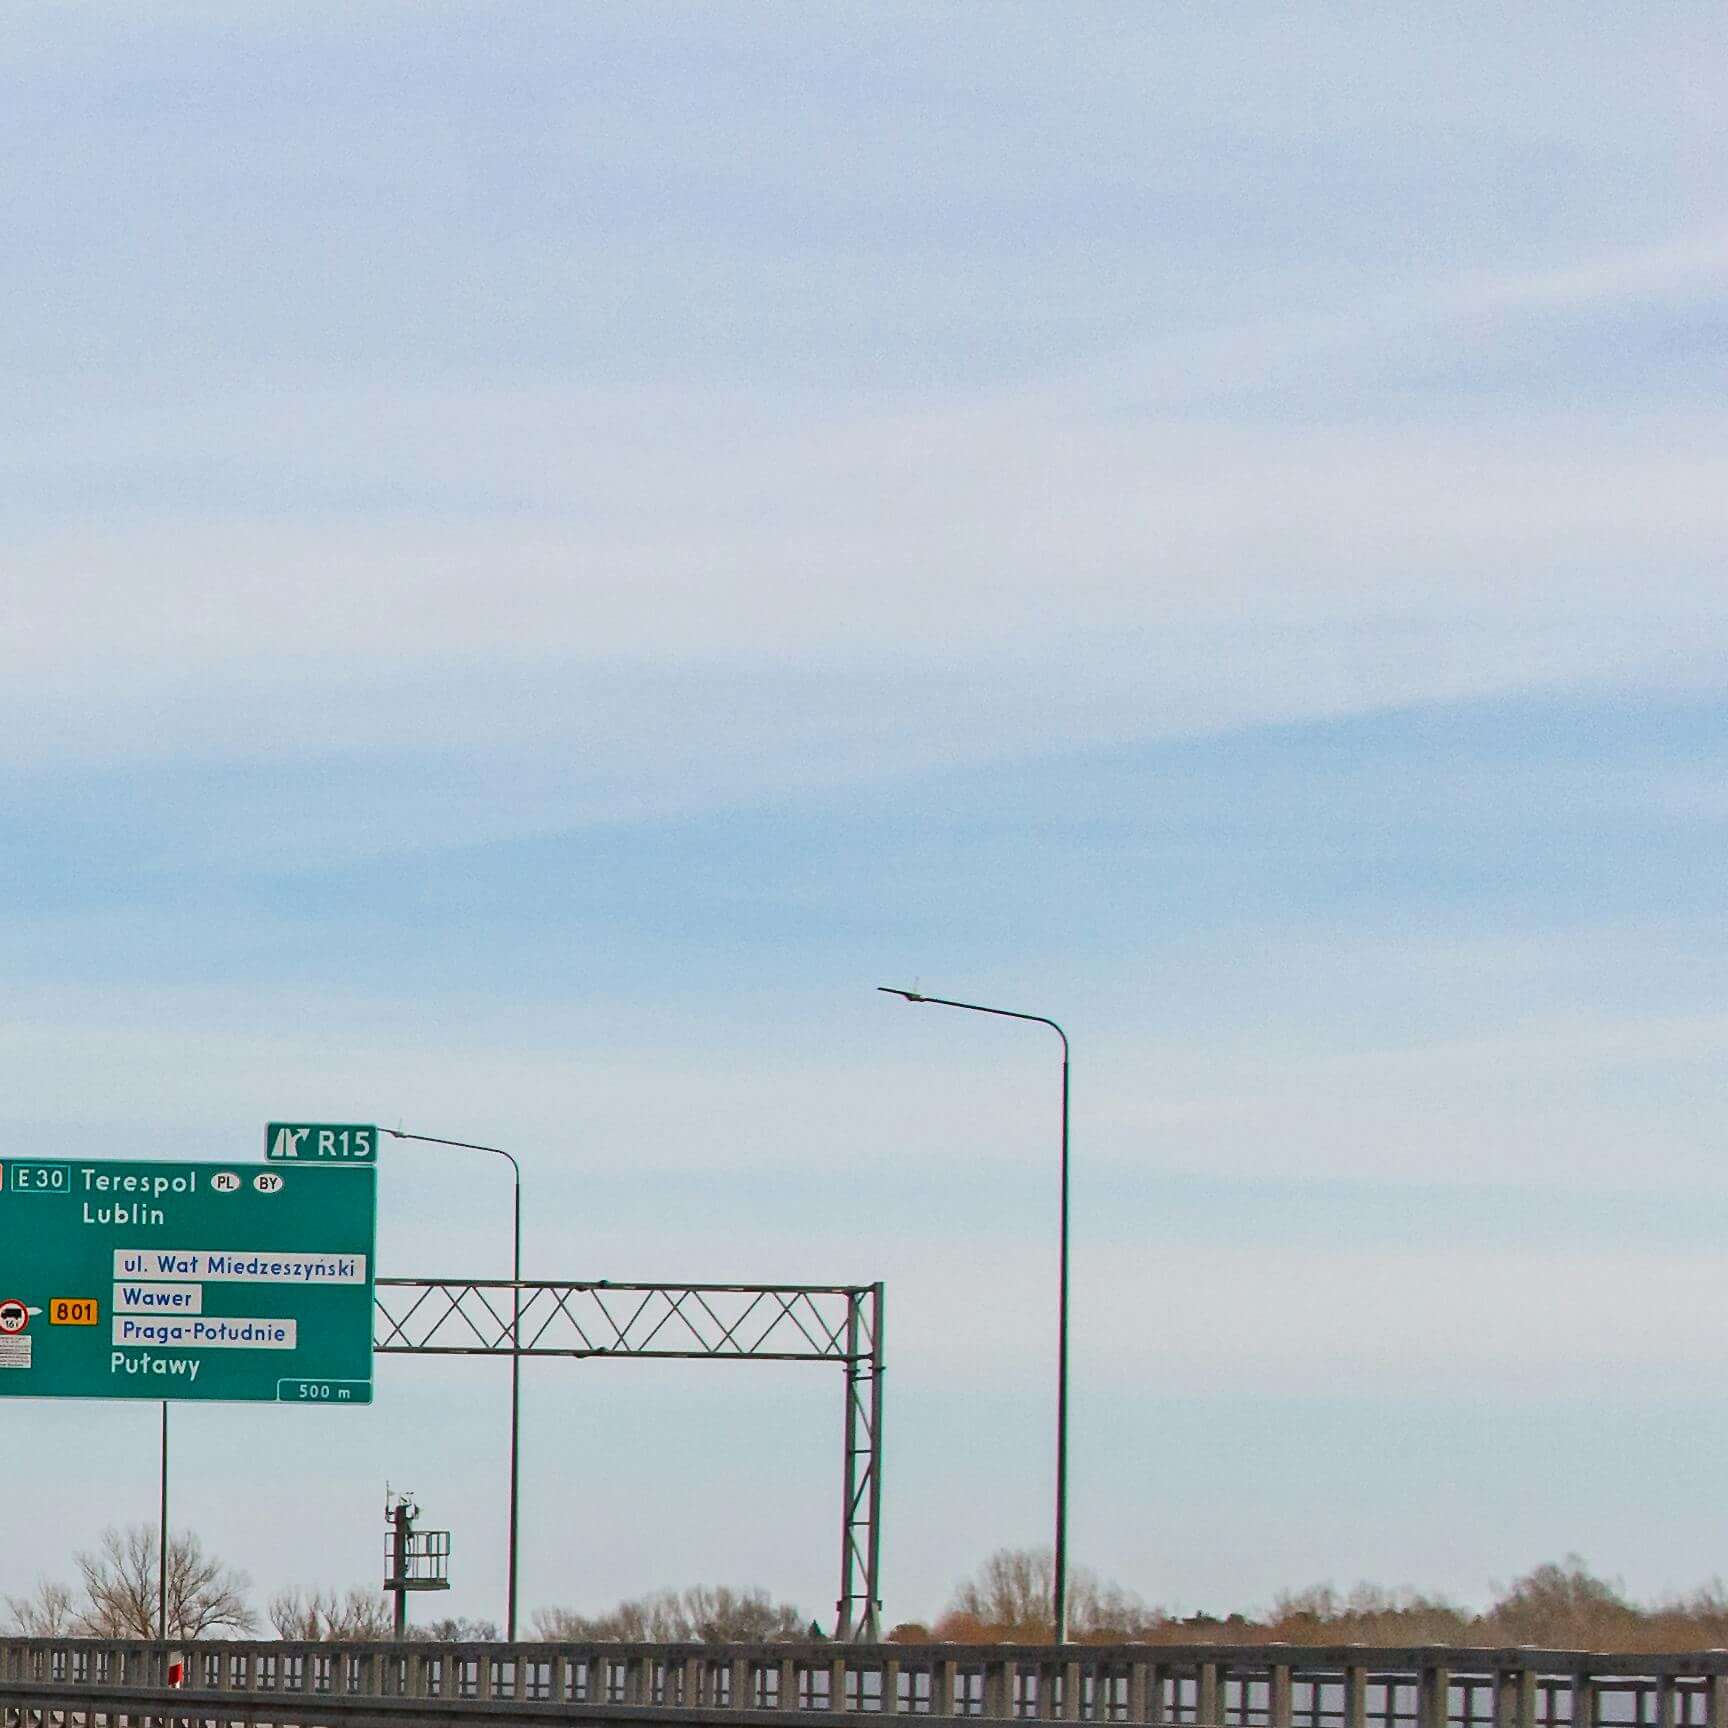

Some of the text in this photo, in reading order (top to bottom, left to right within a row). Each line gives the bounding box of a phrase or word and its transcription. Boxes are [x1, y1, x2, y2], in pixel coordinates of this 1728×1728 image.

[318, 1130, 371, 1157] R15
[81, 1168, 196, 1198] Terespol
[216, 1175, 234, 1190] PL
[258, 1175, 278, 1190] BY
[83, 1202, 165, 1225] Lublin
[124, 1256, 356, 1281] ul. Wał Miedzeszyński
[122, 1287, 192, 1307] Wawer
[56, 1302, 92, 1321] 801
[123, 1320, 286, 1344] Praga-Południe
[110, 1351, 201, 1381] Puławy
[299, 1384, 330, 1399] 500
